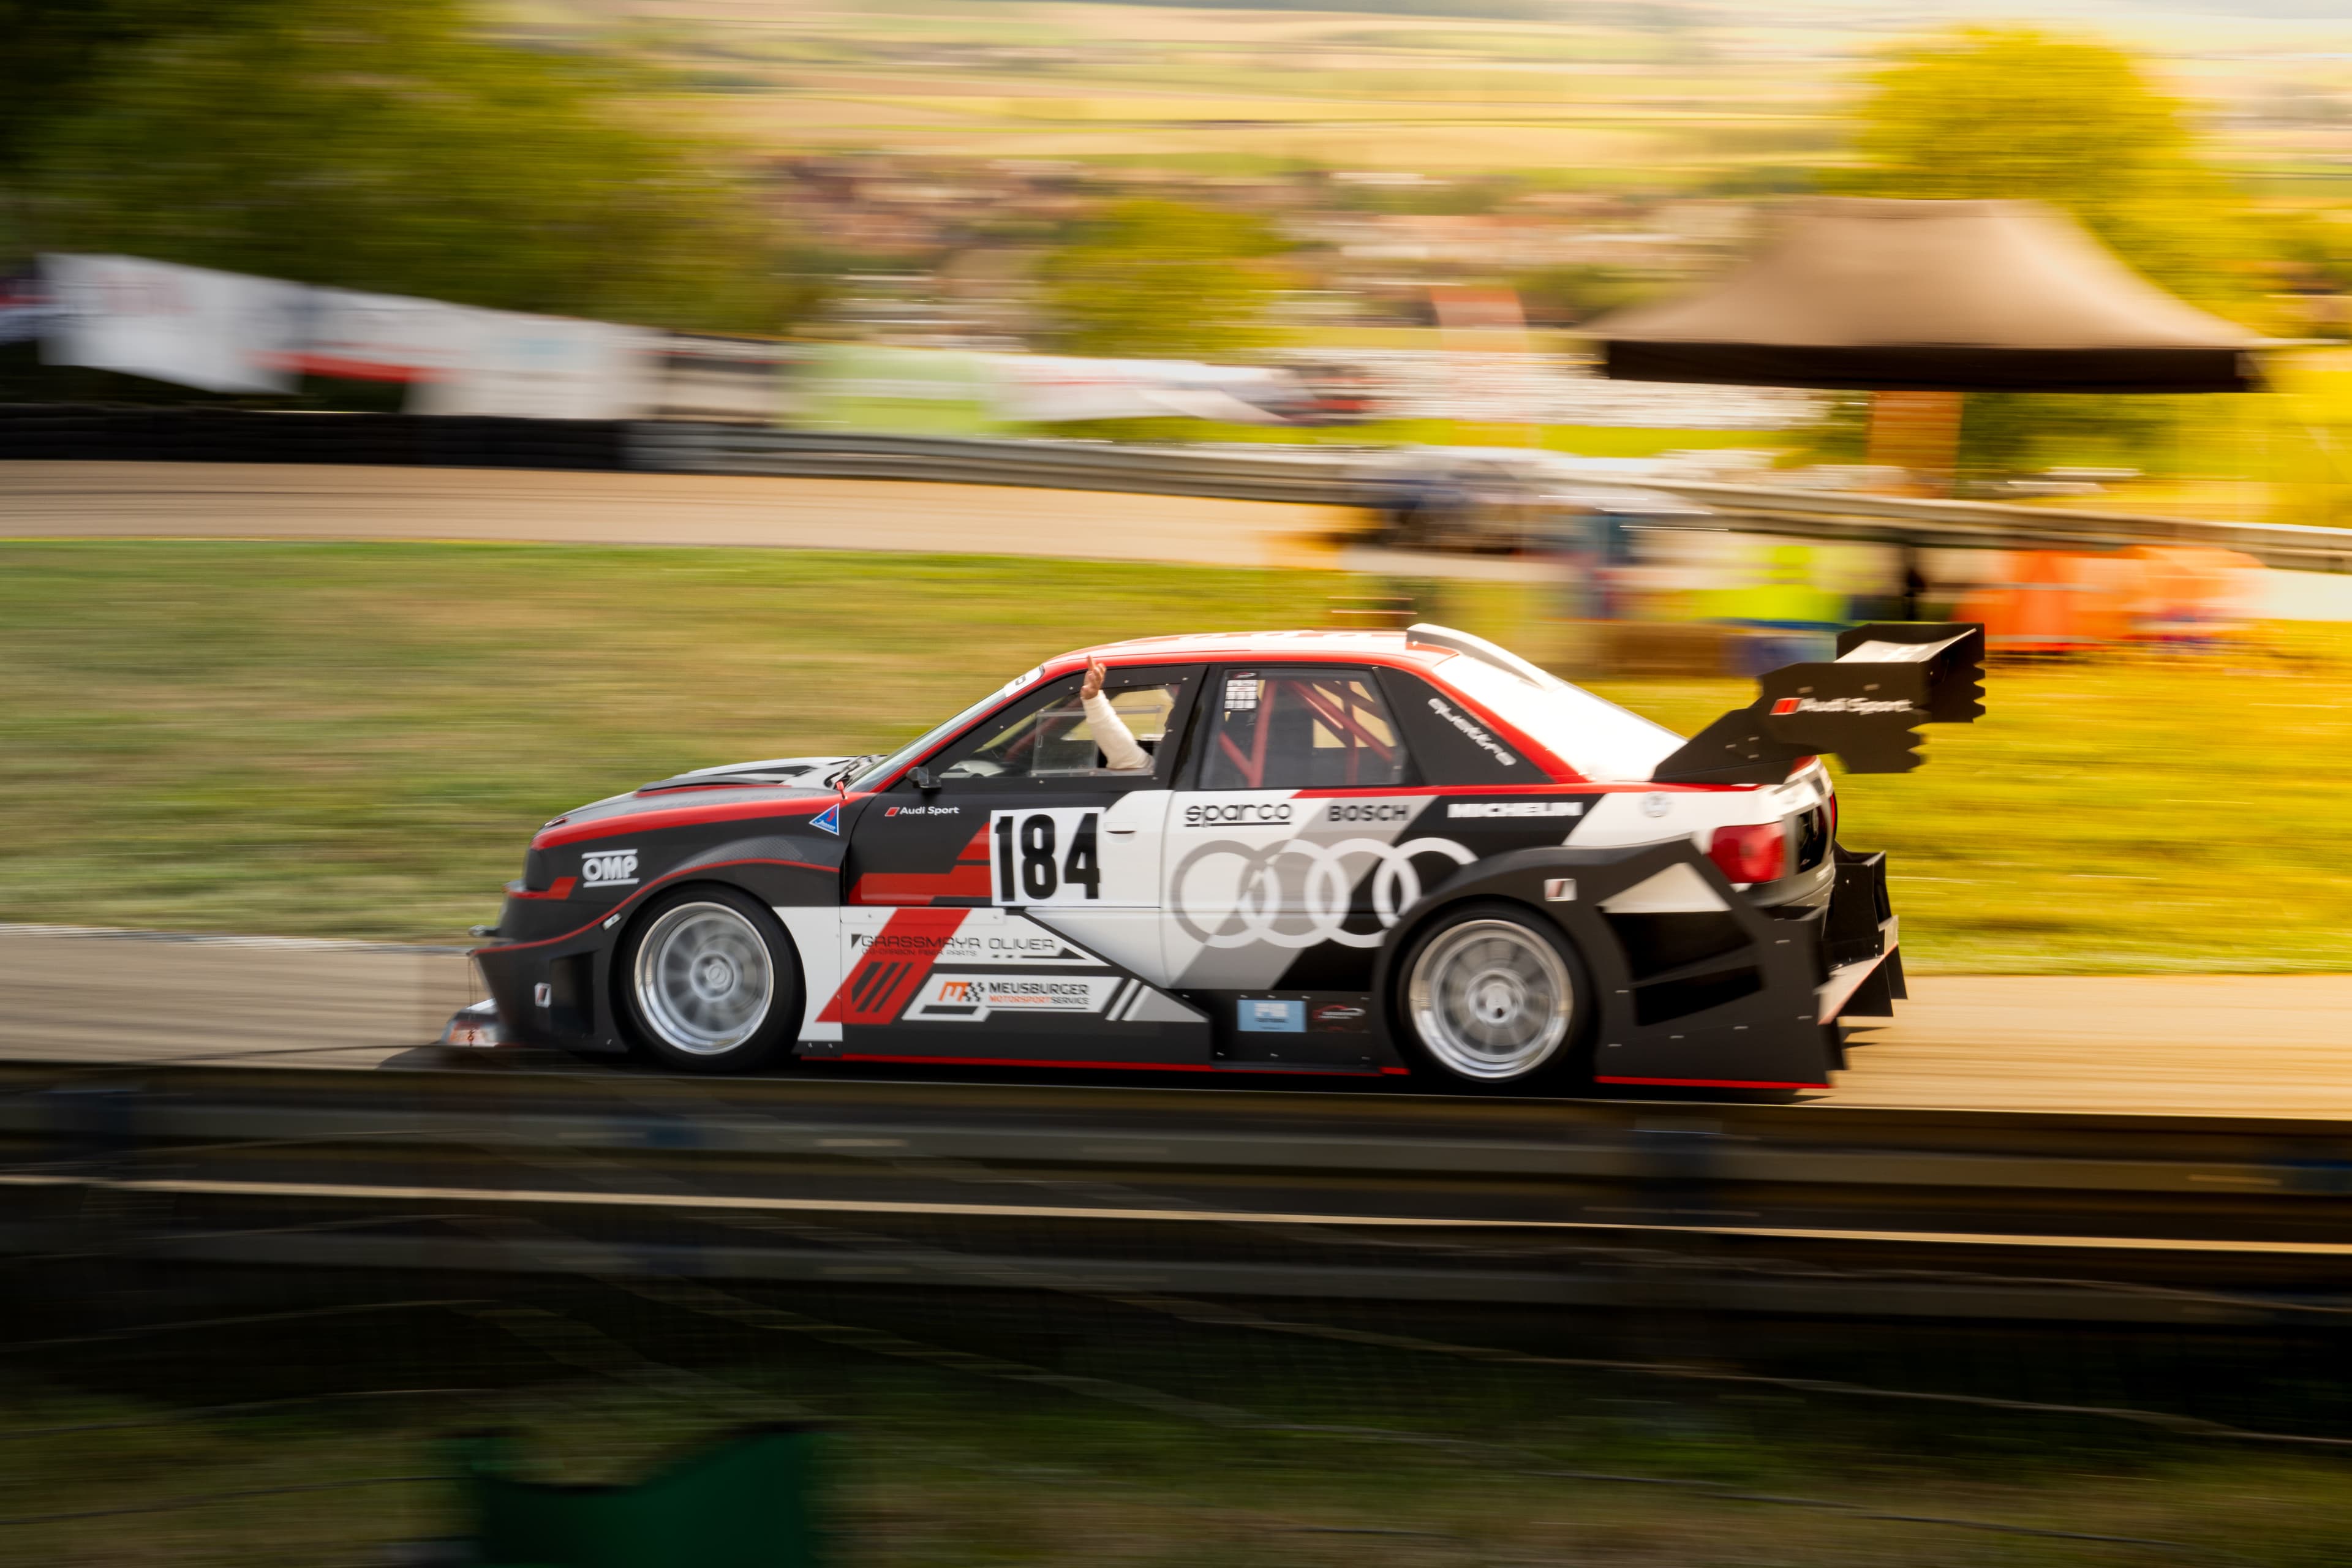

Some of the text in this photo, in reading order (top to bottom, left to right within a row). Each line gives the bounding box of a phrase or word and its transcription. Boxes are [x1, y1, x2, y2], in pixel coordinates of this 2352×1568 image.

[1797, 697, 1913, 715] Audi Sport
[899, 806, 960, 815] Audi Sport
[1185, 804, 1292, 827] sparco
[1327, 804, 1411, 822] BOSCH
[1447, 802, 1584, 818] MICHELIN
[995, 813, 1101, 902] 184
[582, 854, 639, 881] OMP
[989, 938, 1055, 950] OLIVER
[989, 981, 1090, 995] MEUSBURGER
